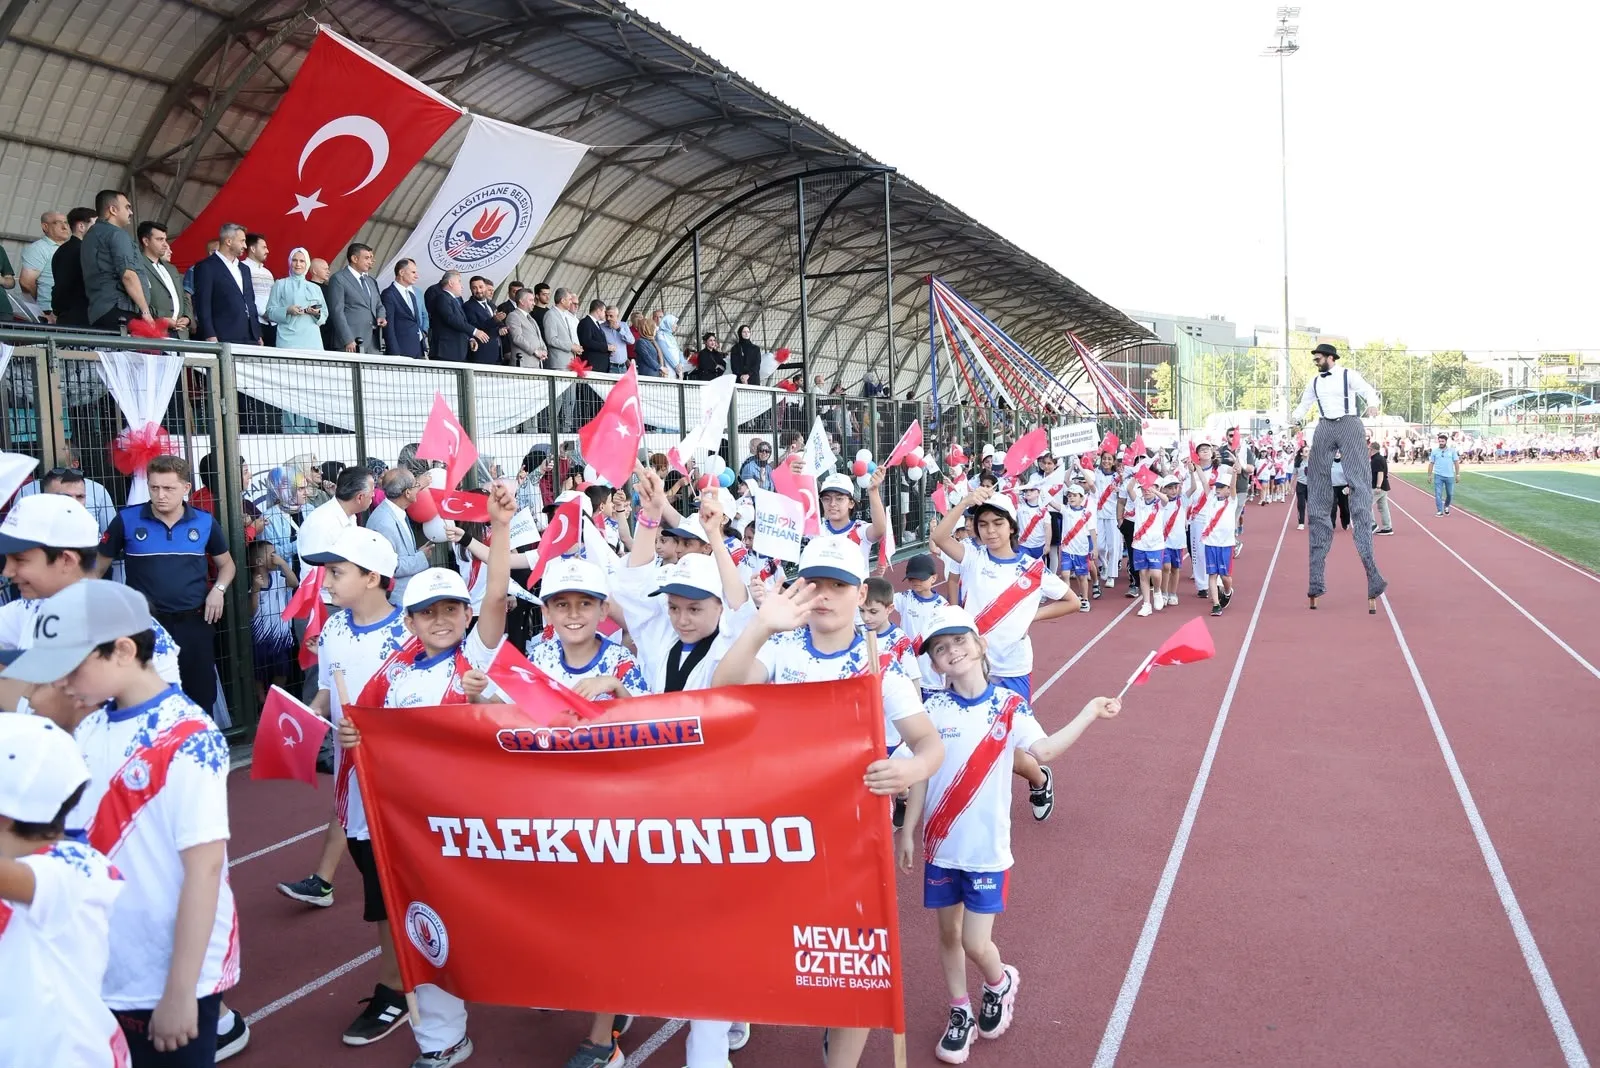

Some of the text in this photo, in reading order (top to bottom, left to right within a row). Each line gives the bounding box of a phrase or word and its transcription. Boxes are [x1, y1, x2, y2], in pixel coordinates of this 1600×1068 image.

[497, 716, 703, 752] SPORCUHANE
[426, 815, 818, 865] TAEKWONDO
[796, 974, 847, 988] BELEDİYE
